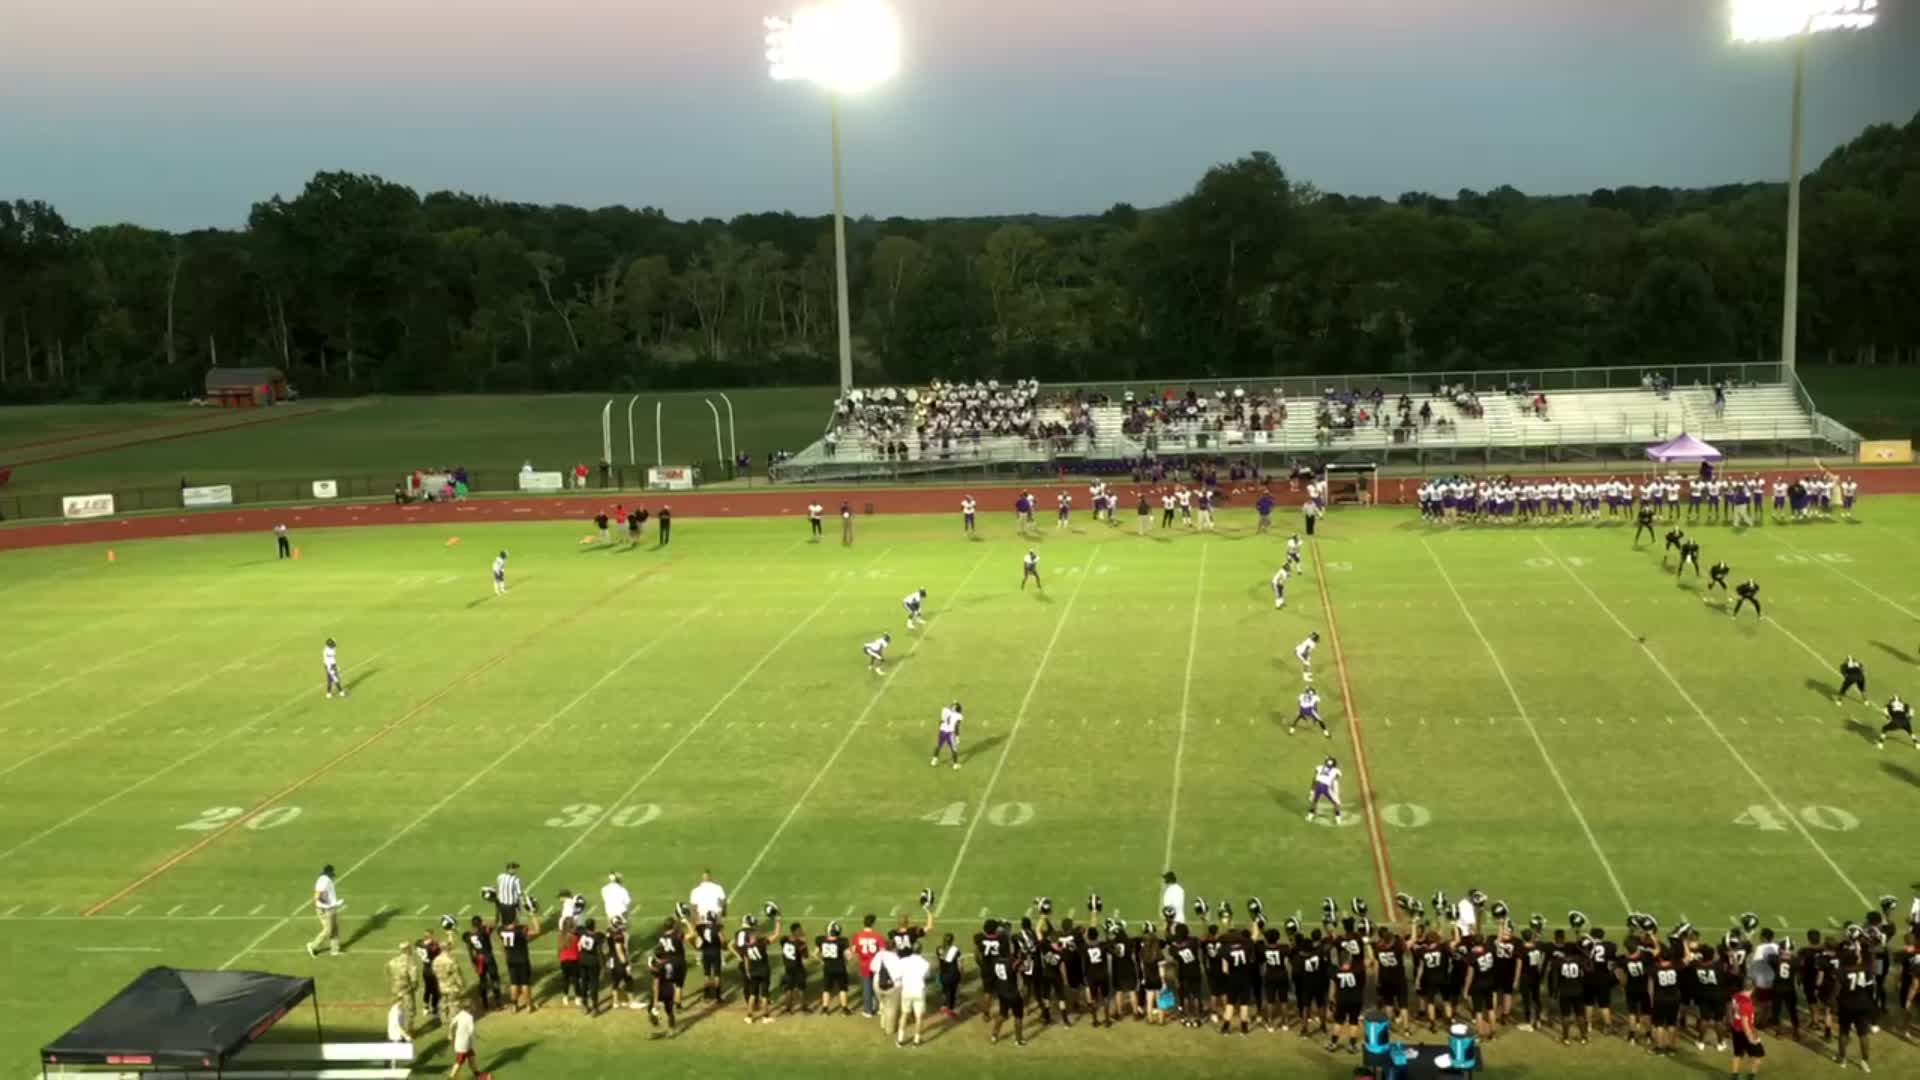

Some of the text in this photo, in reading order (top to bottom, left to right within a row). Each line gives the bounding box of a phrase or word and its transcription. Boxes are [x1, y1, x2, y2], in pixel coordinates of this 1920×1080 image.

[175, 806, 302, 830] 20
[544, 803, 661, 828] 30
[921, 802, 1034, 826] 40
[1733, 805, 1860, 831] 40
[982, 940, 1000, 956] 73
[1087, 947, 1102, 963] 12
[1424, 951, 1441, 968] 27
[1779, 962, 1791, 979] 6
[1336, 972, 1357, 989] 70
